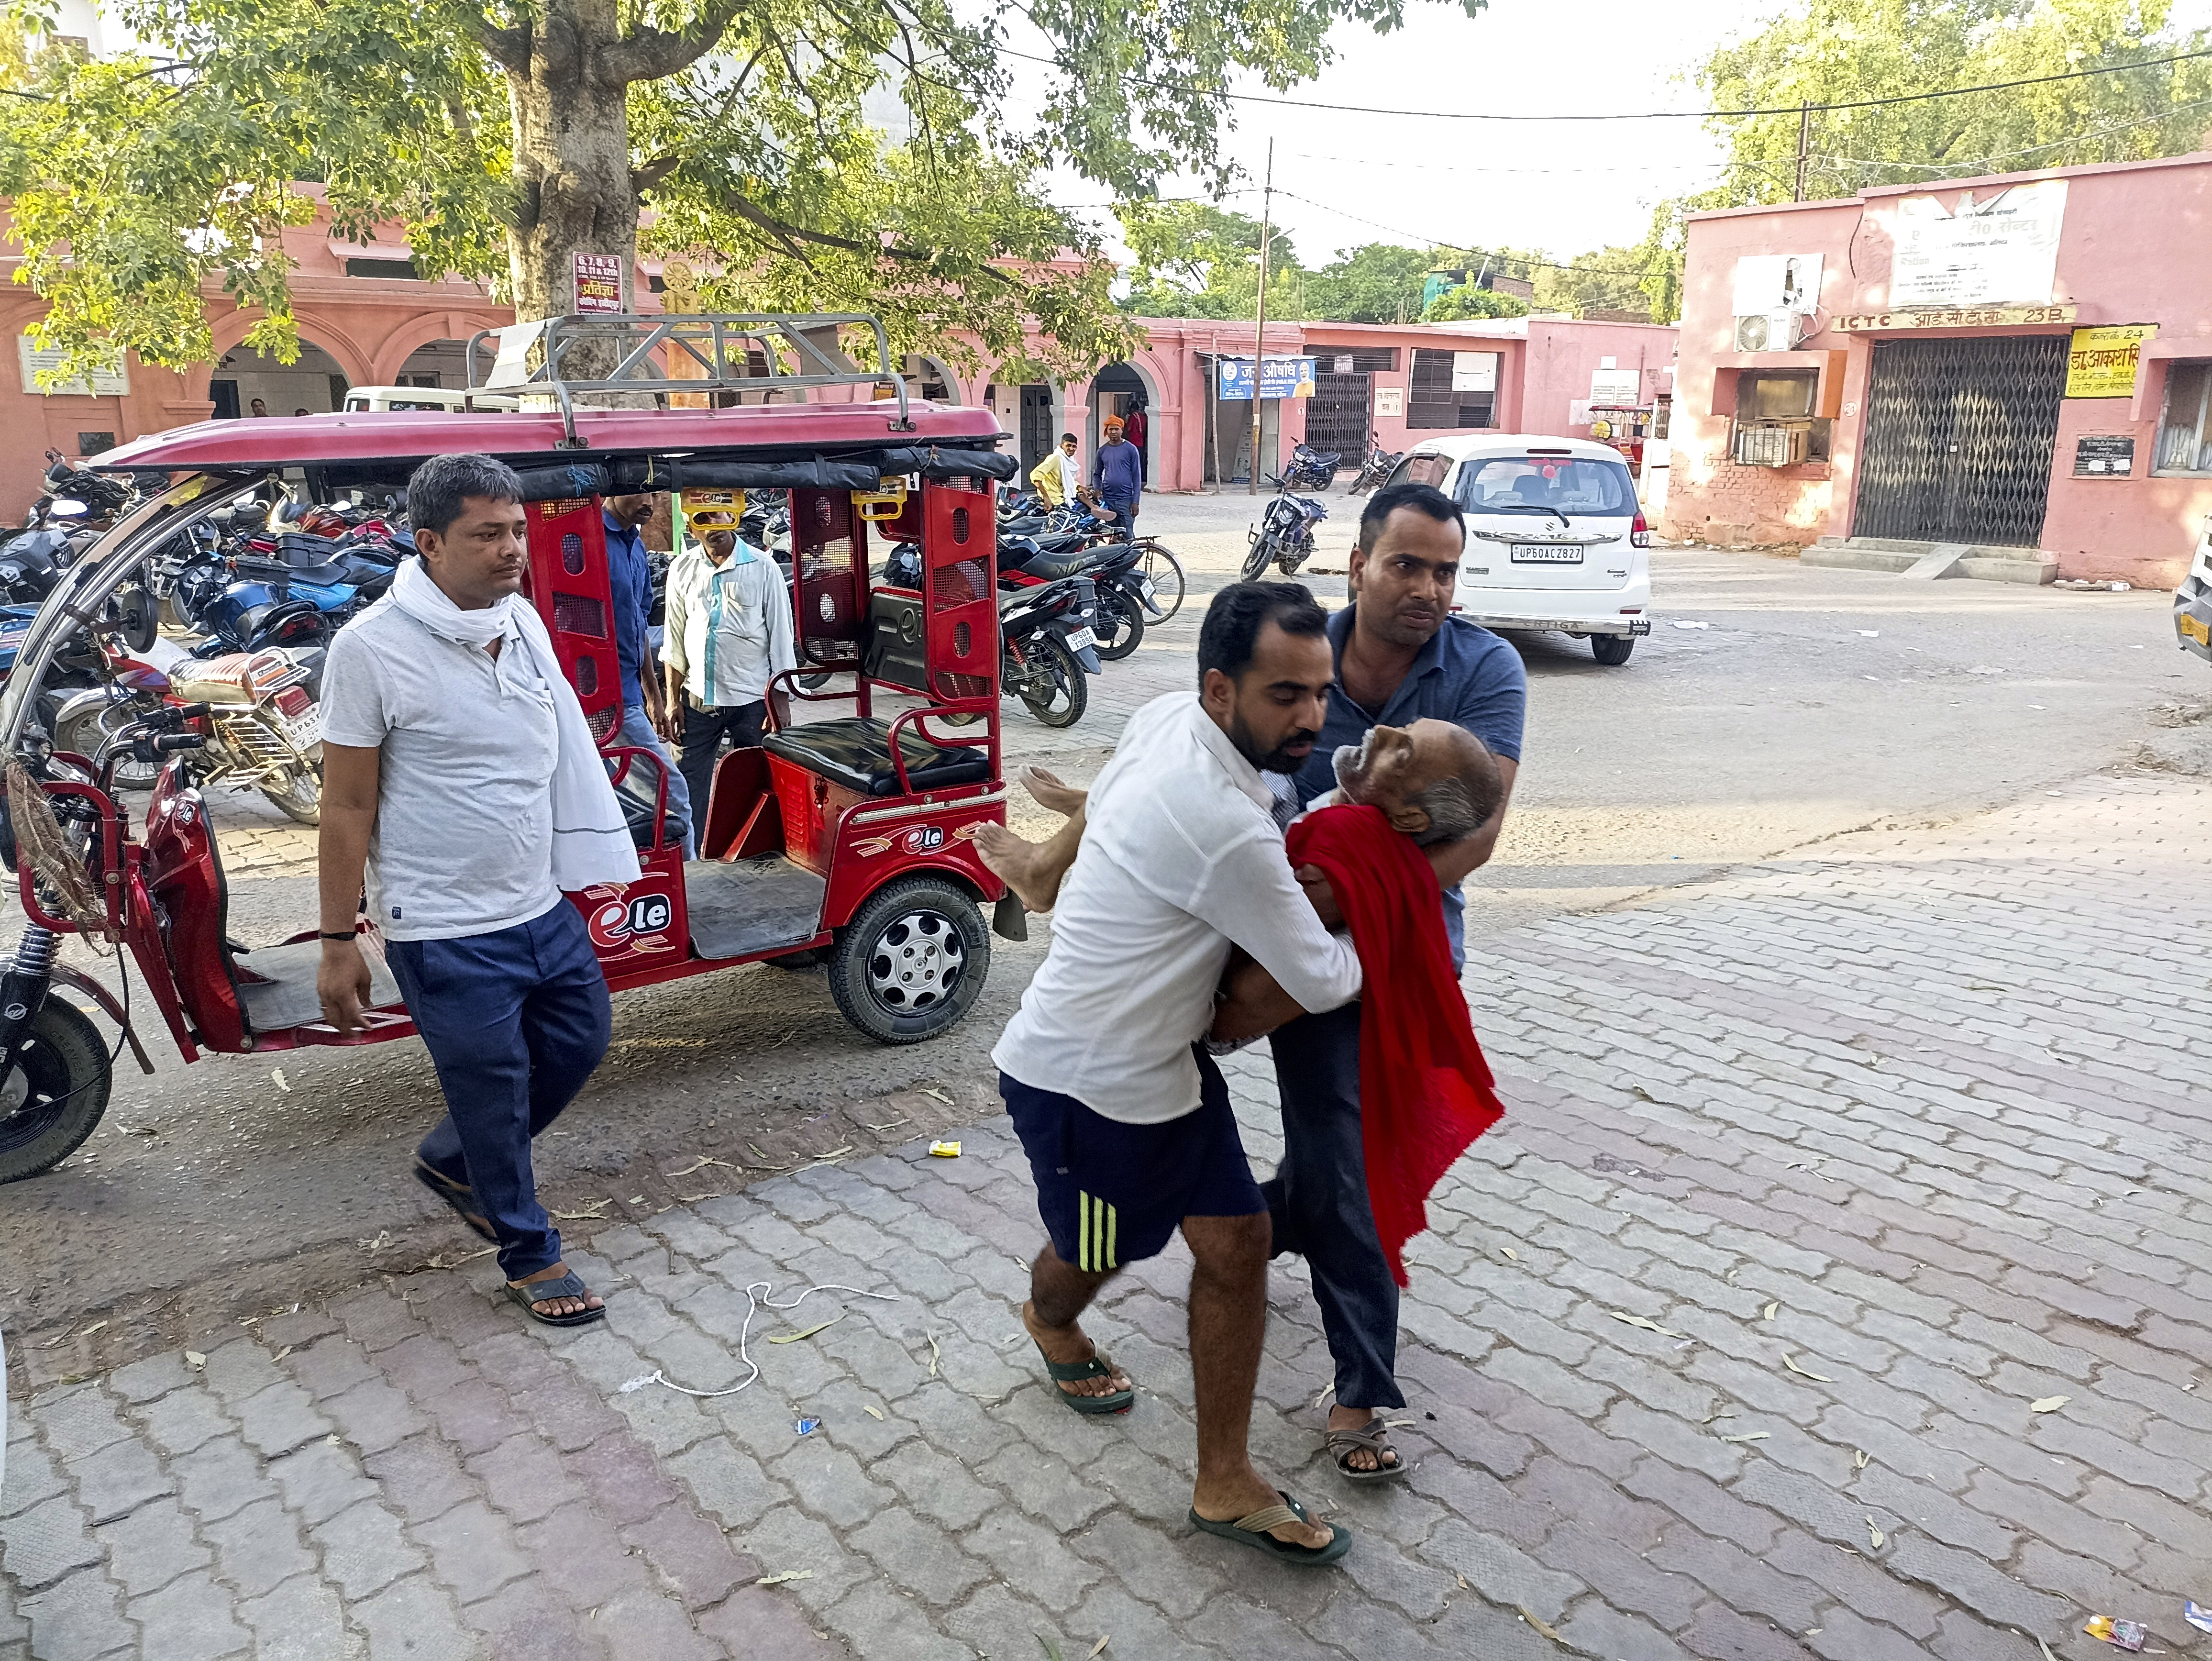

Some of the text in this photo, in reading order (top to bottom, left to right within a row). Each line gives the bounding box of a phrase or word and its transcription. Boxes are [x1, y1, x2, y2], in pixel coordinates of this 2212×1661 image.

[582, 280, 614, 297] प्रतिज्ञा
[1840, 314, 1891, 329] ICTC
[1263, 361, 1296, 377] औषधि
[1520, 548, 1581, 559] UP60AC2827
[1071, 630, 1090, 642] UP60A
[903, 829, 941, 854] ele
[588, 901, 667, 947] ele
